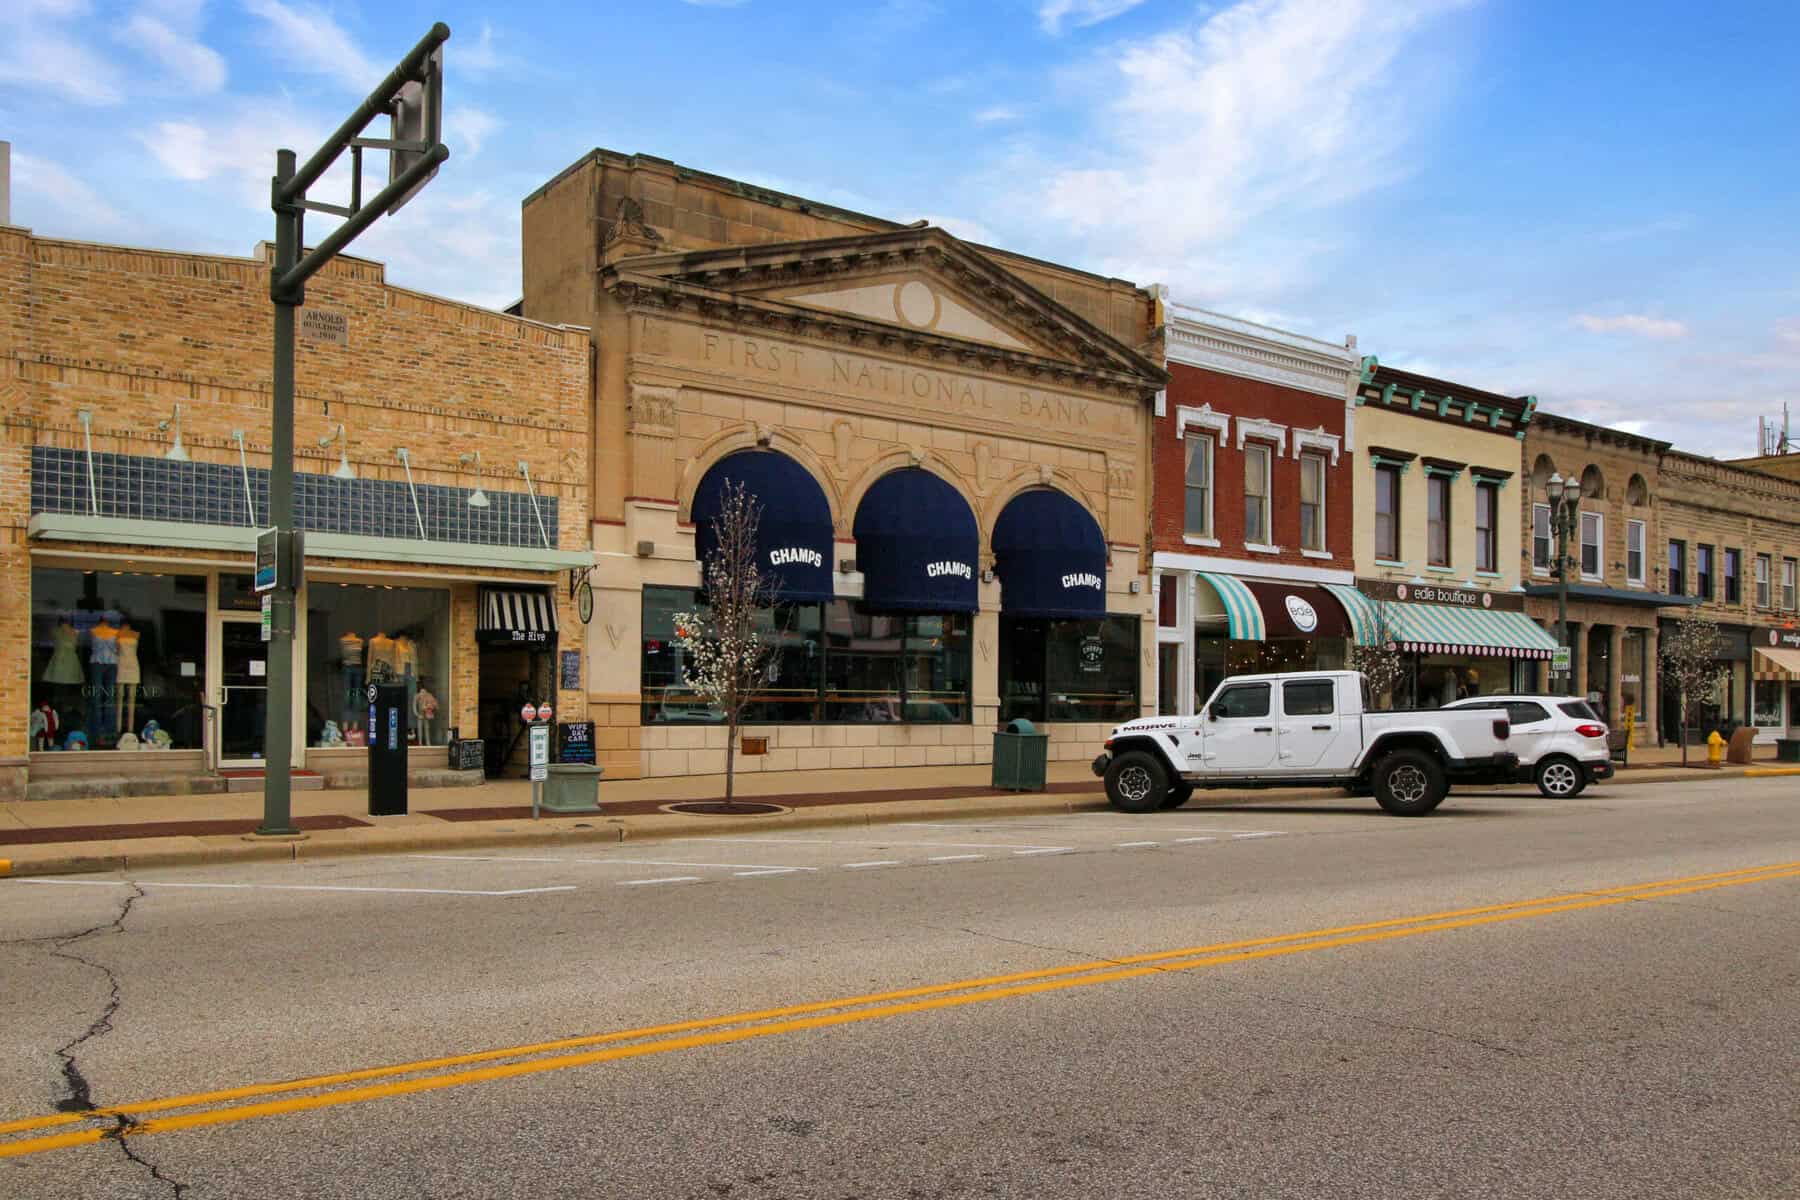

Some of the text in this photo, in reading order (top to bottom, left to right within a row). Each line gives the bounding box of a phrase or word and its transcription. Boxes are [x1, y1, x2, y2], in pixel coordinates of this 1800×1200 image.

[305, 312, 343, 324] ARNOLD
[703, 334, 1090, 425] FIRST NATIONAL BANK
[769, 547, 823, 568] CHAMPS
[926, 561, 972, 580] CHAMPS
[1061, 573, 1102, 590] CHAMPS
[1414, 587, 1476, 605] edie boutique
[511, 630, 546, 642] The Hive
[571, 729, 585, 737] DAY
[1123, 722, 1177, 732] MOJAVE
